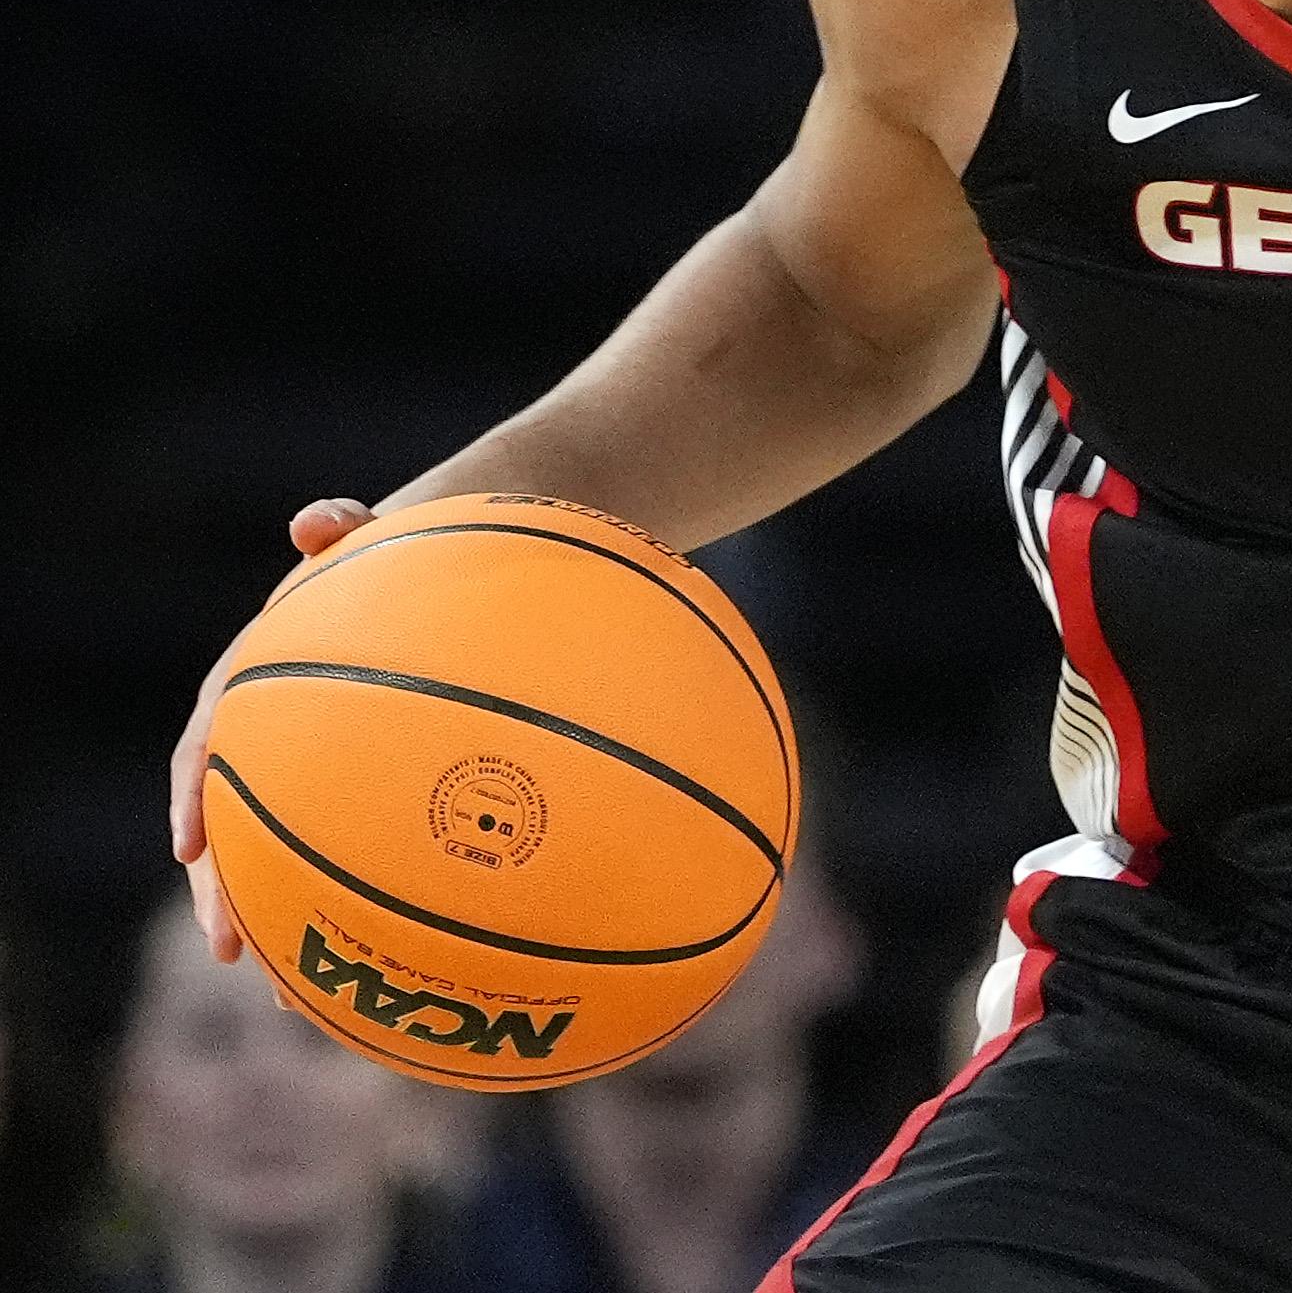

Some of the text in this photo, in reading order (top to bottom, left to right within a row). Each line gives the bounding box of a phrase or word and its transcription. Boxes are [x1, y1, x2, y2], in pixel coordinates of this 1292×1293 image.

[449, 844, 497, 867] SIZE 7
[298, 921, 576, 1059] NCAA
[314, 909, 581, 1006] OFFICIAL GAME BALL
